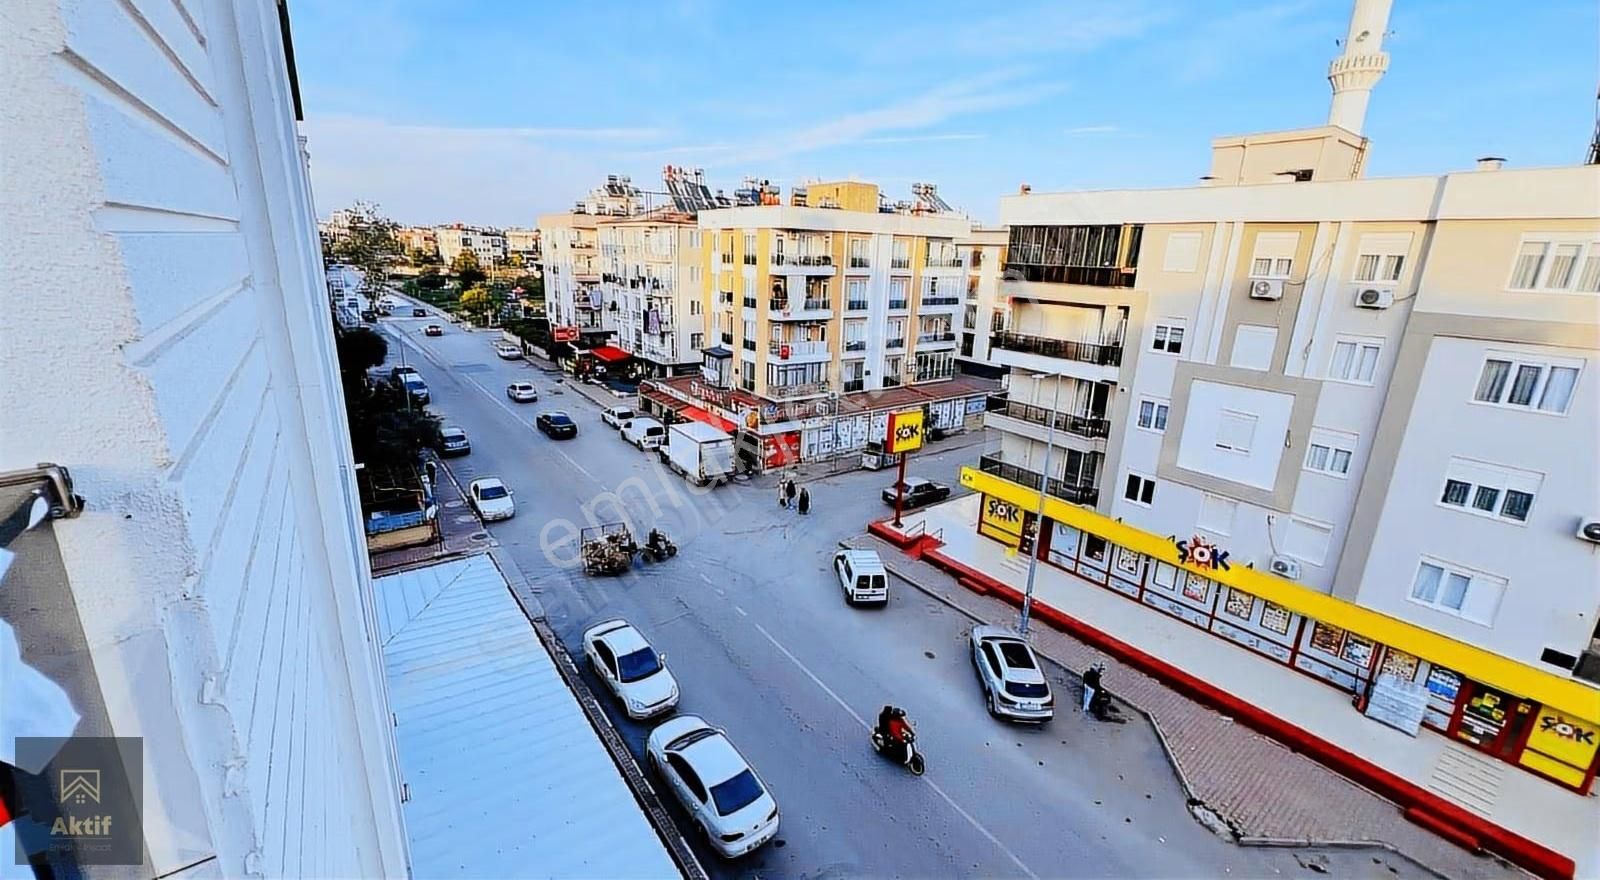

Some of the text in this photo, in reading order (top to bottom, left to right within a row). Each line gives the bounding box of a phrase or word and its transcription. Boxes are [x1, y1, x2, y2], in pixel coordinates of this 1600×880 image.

[896, 424, 919, 442] ŞOK
[988, 500, 1019, 523] ŞOK
[1176, 538, 1231, 572] ŞOK
[1540, 715, 1595, 746] ŞOK
